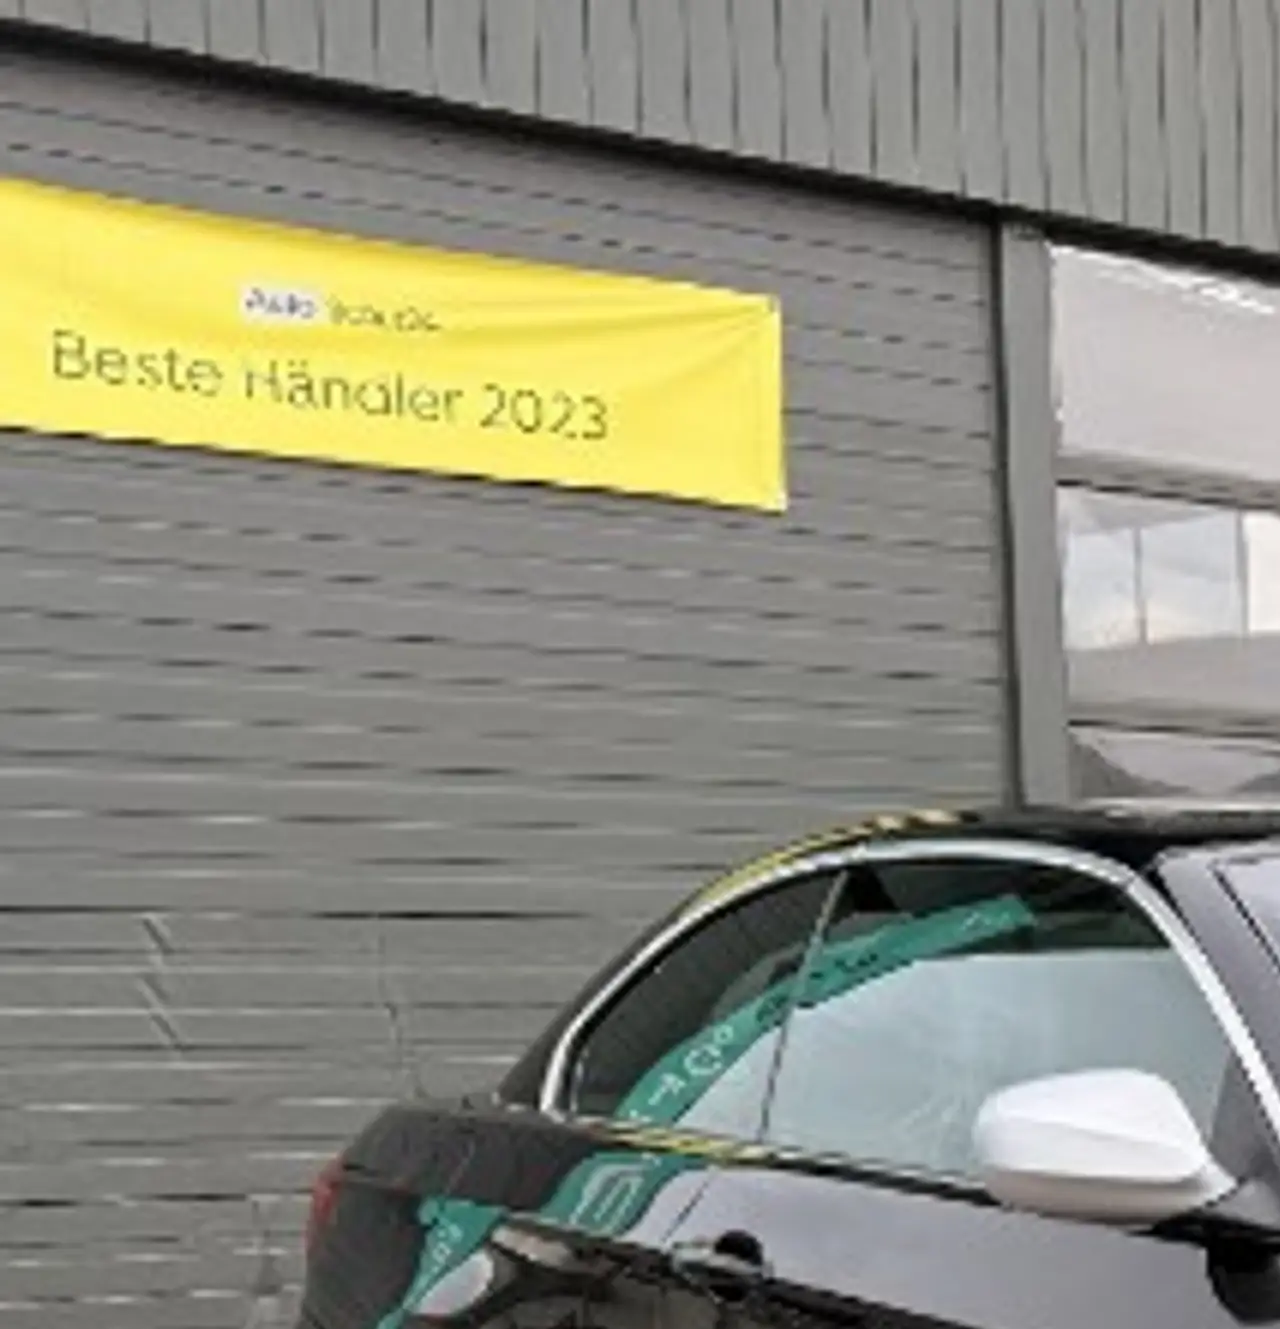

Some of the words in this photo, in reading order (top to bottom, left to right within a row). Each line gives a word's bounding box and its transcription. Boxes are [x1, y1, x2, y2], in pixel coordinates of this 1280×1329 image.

[51, 328, 224, 399] Beste
[244, 357, 463, 423] Händler
[479, 382, 609, 441] 2023
